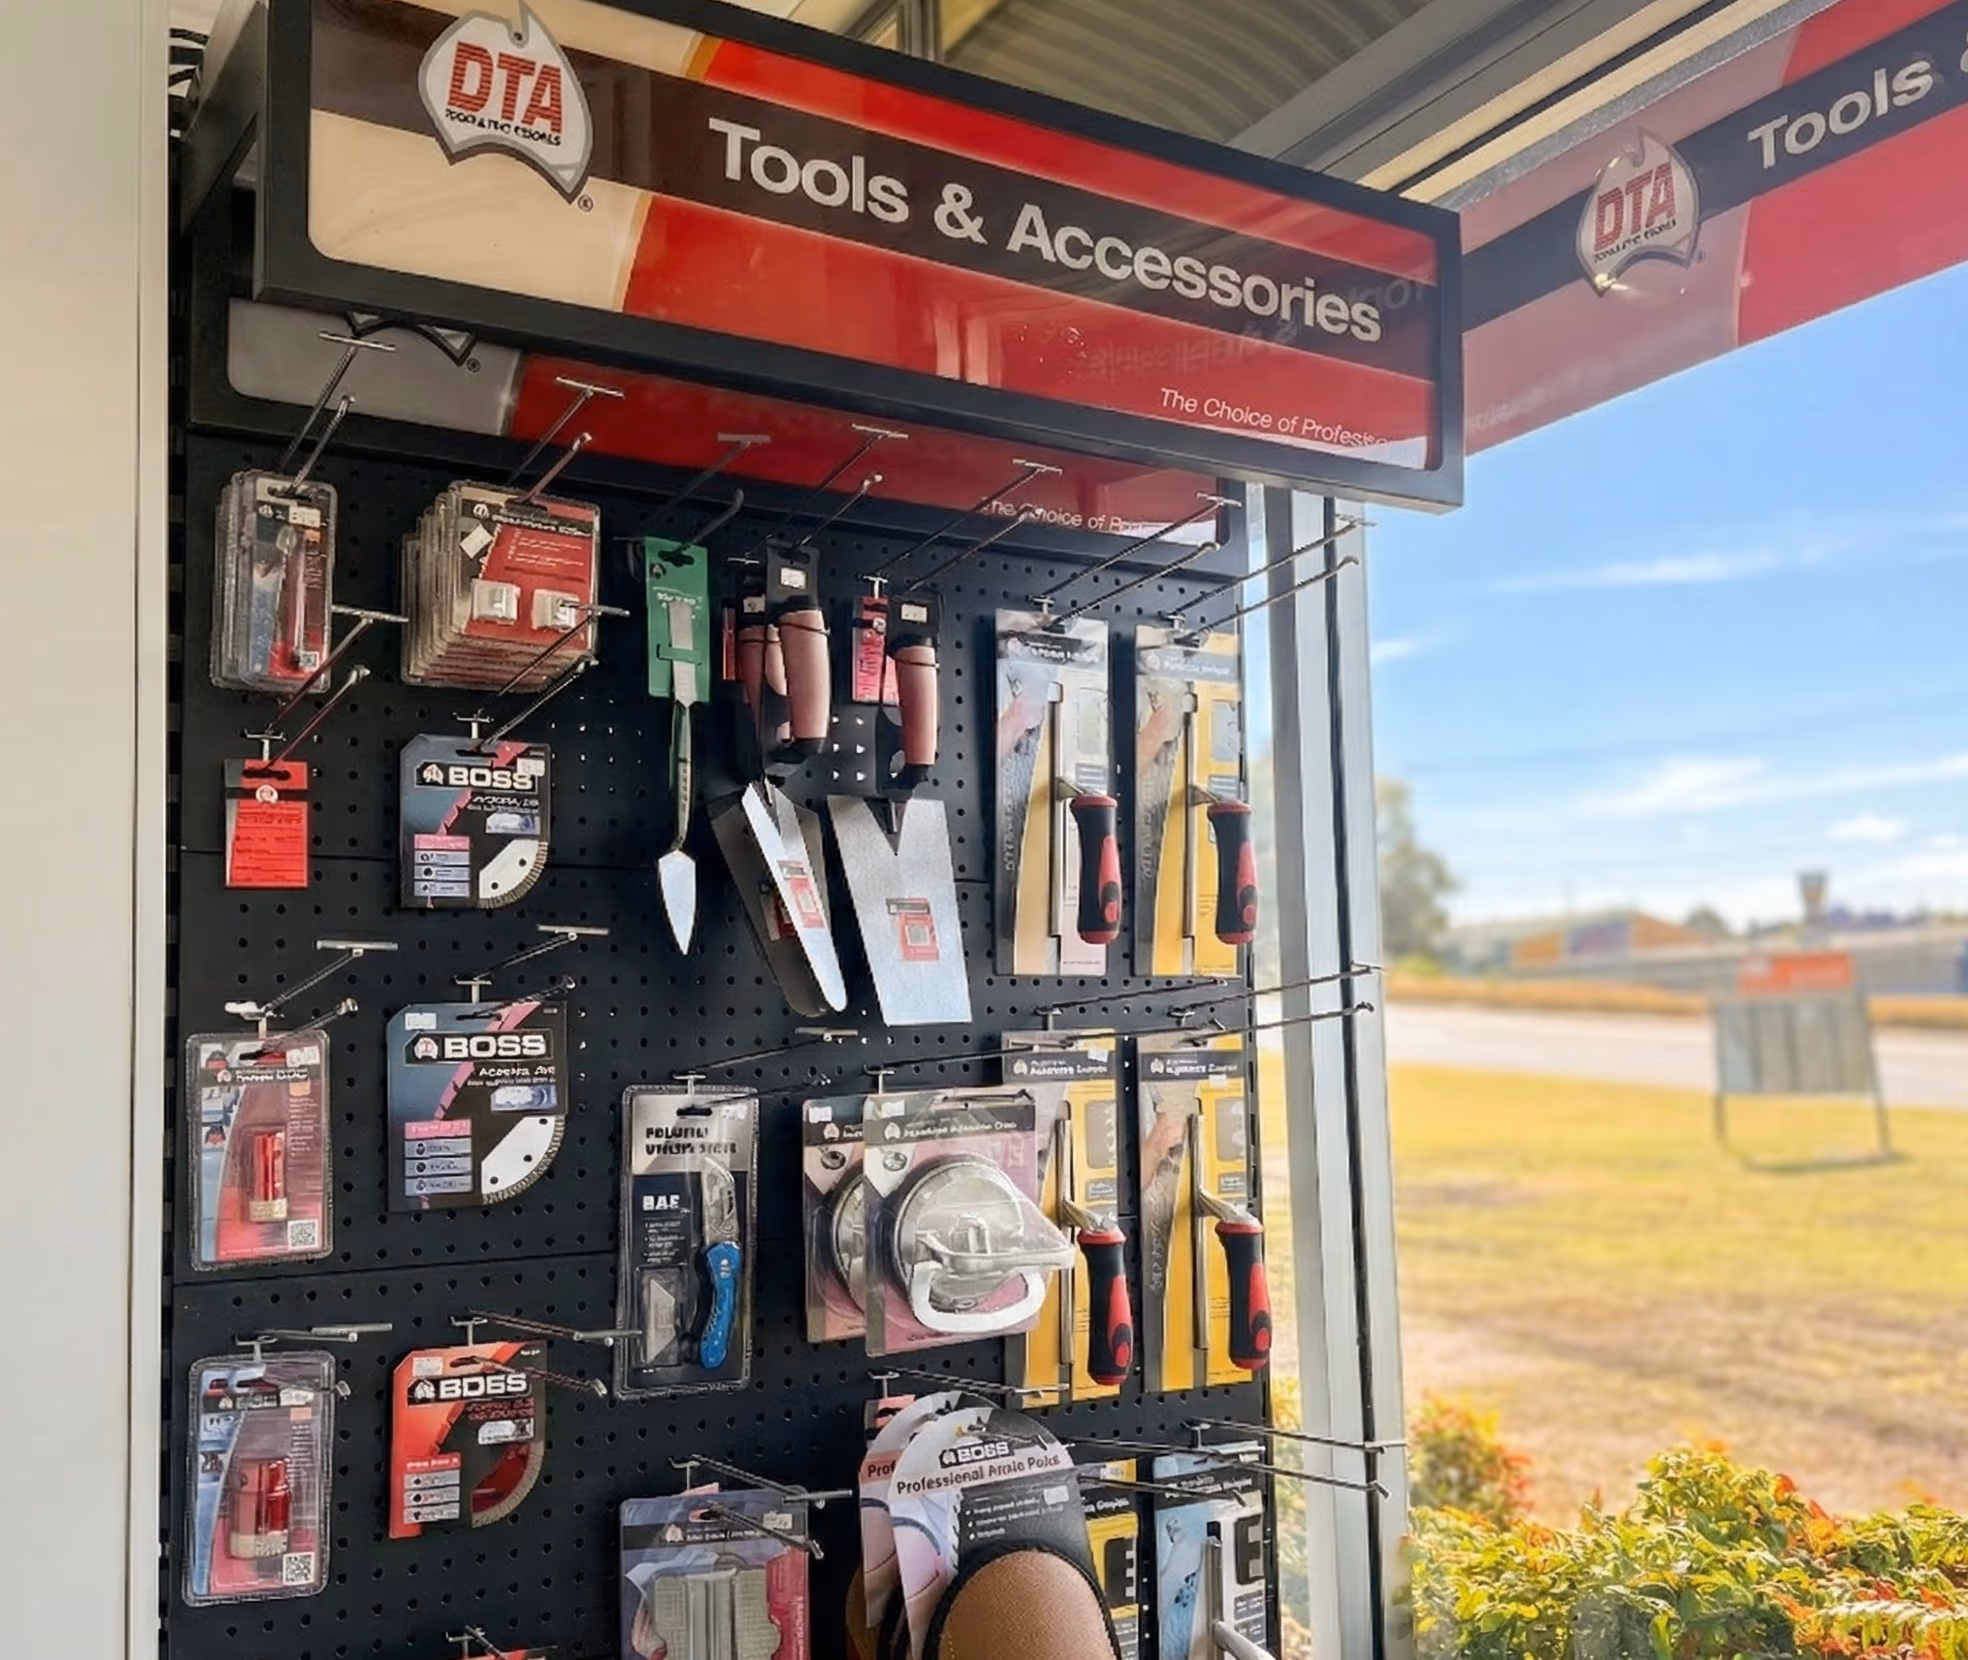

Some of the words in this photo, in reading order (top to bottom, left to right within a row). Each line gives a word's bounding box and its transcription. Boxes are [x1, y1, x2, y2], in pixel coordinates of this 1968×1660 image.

[447, 41, 562, 134] DTA
[1748, 60, 1934, 169] Tools
[708, 117, 909, 222] Tools
[933, 183, 988, 245] &
[1006, 204, 1383, 343] Accessories
[1594, 161, 1676, 252] DTA
[1161, 388, 1198, 413] The
[1203, 398, 1273, 428] Choice
[1277, 416, 1300, 433] of
[1087, 514, 1106, 530] of
[448, 766, 533, 790] BOSS
[444, 1034, 546, 1058] BOSS
